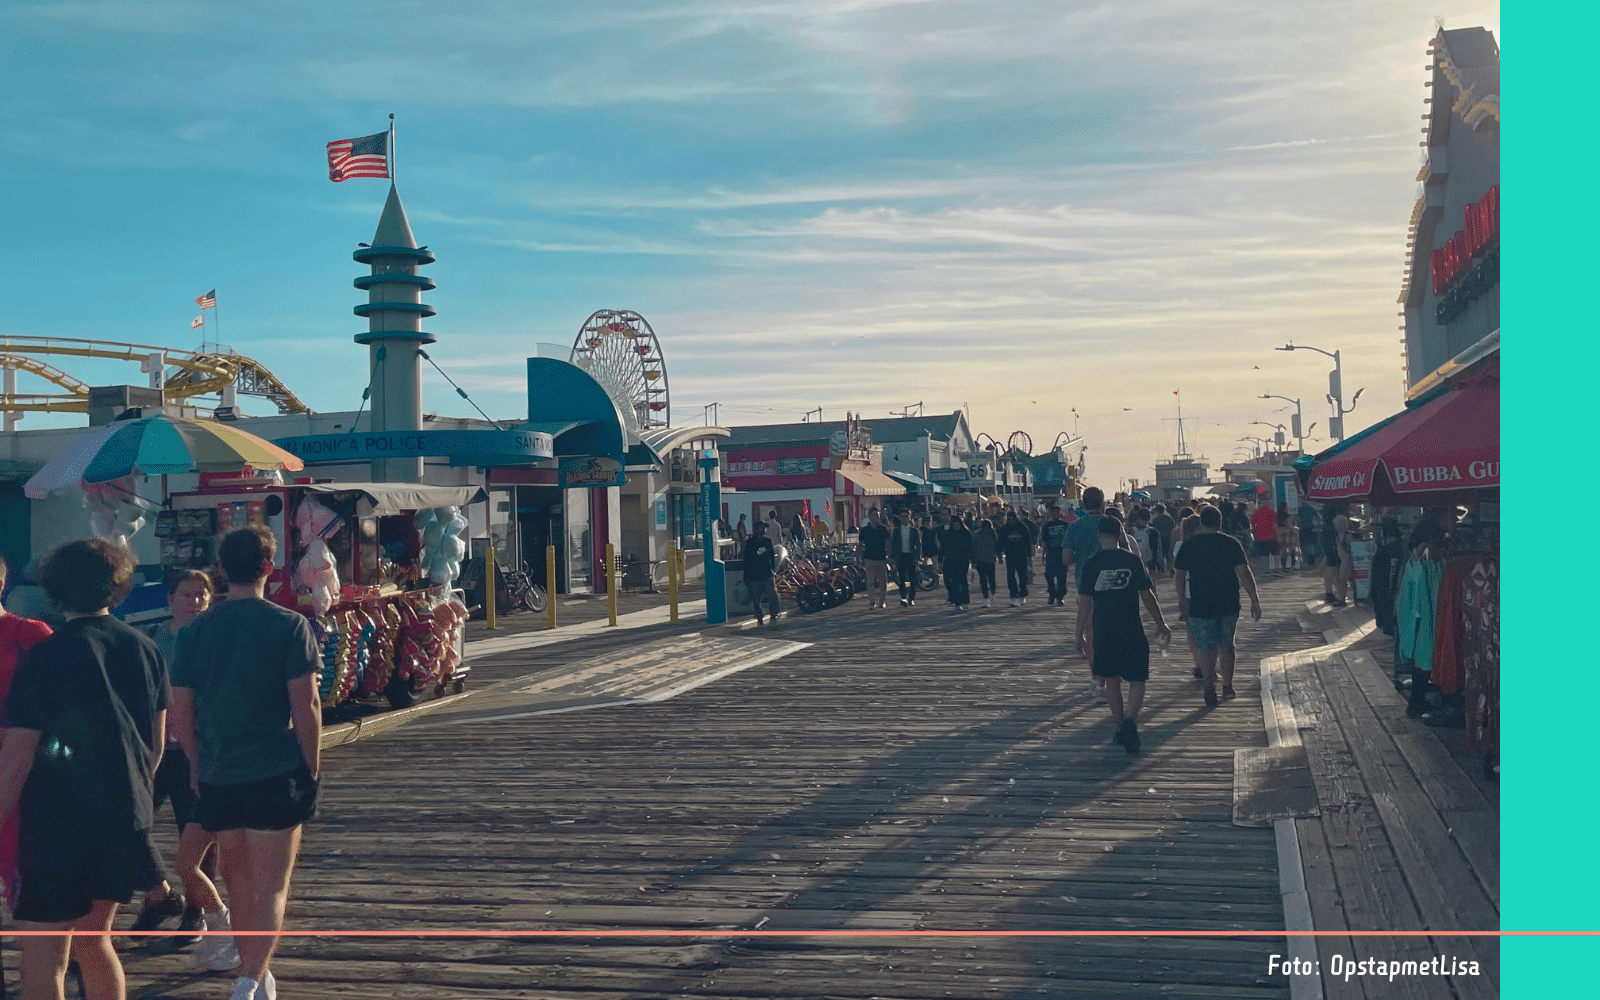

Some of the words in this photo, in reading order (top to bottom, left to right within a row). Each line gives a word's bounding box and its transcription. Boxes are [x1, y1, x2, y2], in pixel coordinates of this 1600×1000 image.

[302, 438, 359, 455] MONICA
[365, 435, 428, 451] POLICE
[515, 436, 544, 450] SANTA
[969, 463, 985, 478] 66
[1393, 464, 1463, 485] BUBBA
[1311, 475, 1351, 490] SHRIMP
[703, 484, 711, 531] Emergency
